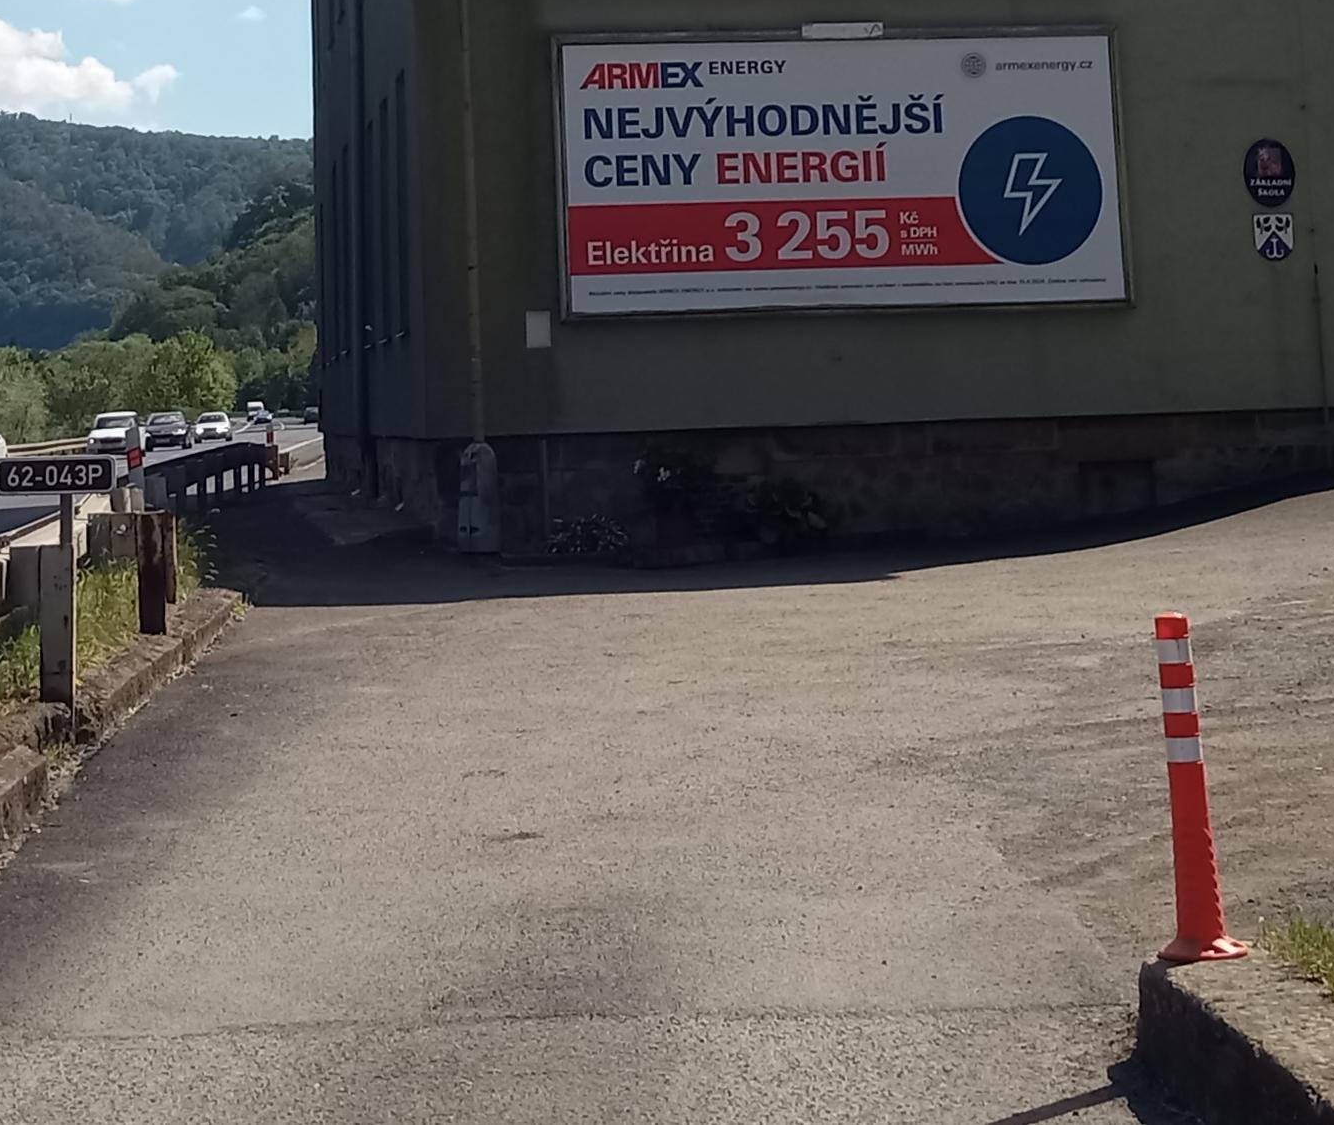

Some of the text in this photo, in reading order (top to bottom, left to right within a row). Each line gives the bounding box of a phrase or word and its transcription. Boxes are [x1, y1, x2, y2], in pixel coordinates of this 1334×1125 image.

[995, 60, 1094, 72] armexenergy.cz
[580, 59, 787, 90] ARMEX ENERGY
[583, 93, 945, 140] NEJVÝHODNĚJŠÍ
[583, 141, 887, 187] CENY ENERGIÍ
[1250, 178, 1292, 186] ZÁKLADNÍ
[1258, 188, 1285, 196] ŠKOLA
[899, 211, 919, 225] Kč
[586, 209, 890, 266] Elektřina 3 255
[900, 227, 937, 239] s DPH
[901, 243, 938, 256] MWh
[7, 464, 103, 487] 62-043P
